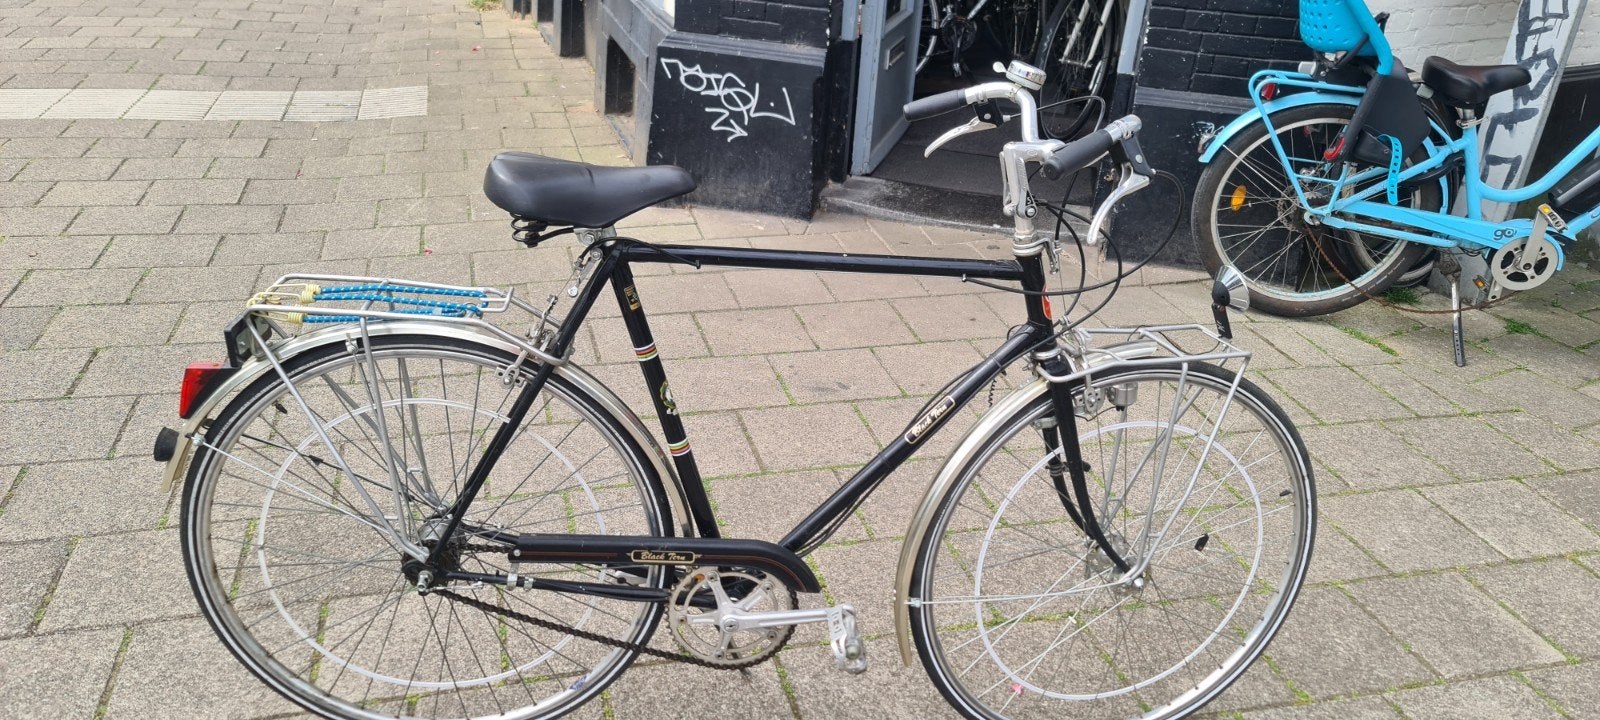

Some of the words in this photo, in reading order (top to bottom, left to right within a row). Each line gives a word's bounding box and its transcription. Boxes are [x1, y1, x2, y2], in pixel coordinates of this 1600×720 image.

[911, 415, 932, 437] Black
[930, 404, 948, 419] Tern
[641, 550, 665, 560] Black
[668, 552, 686, 561] Tern
